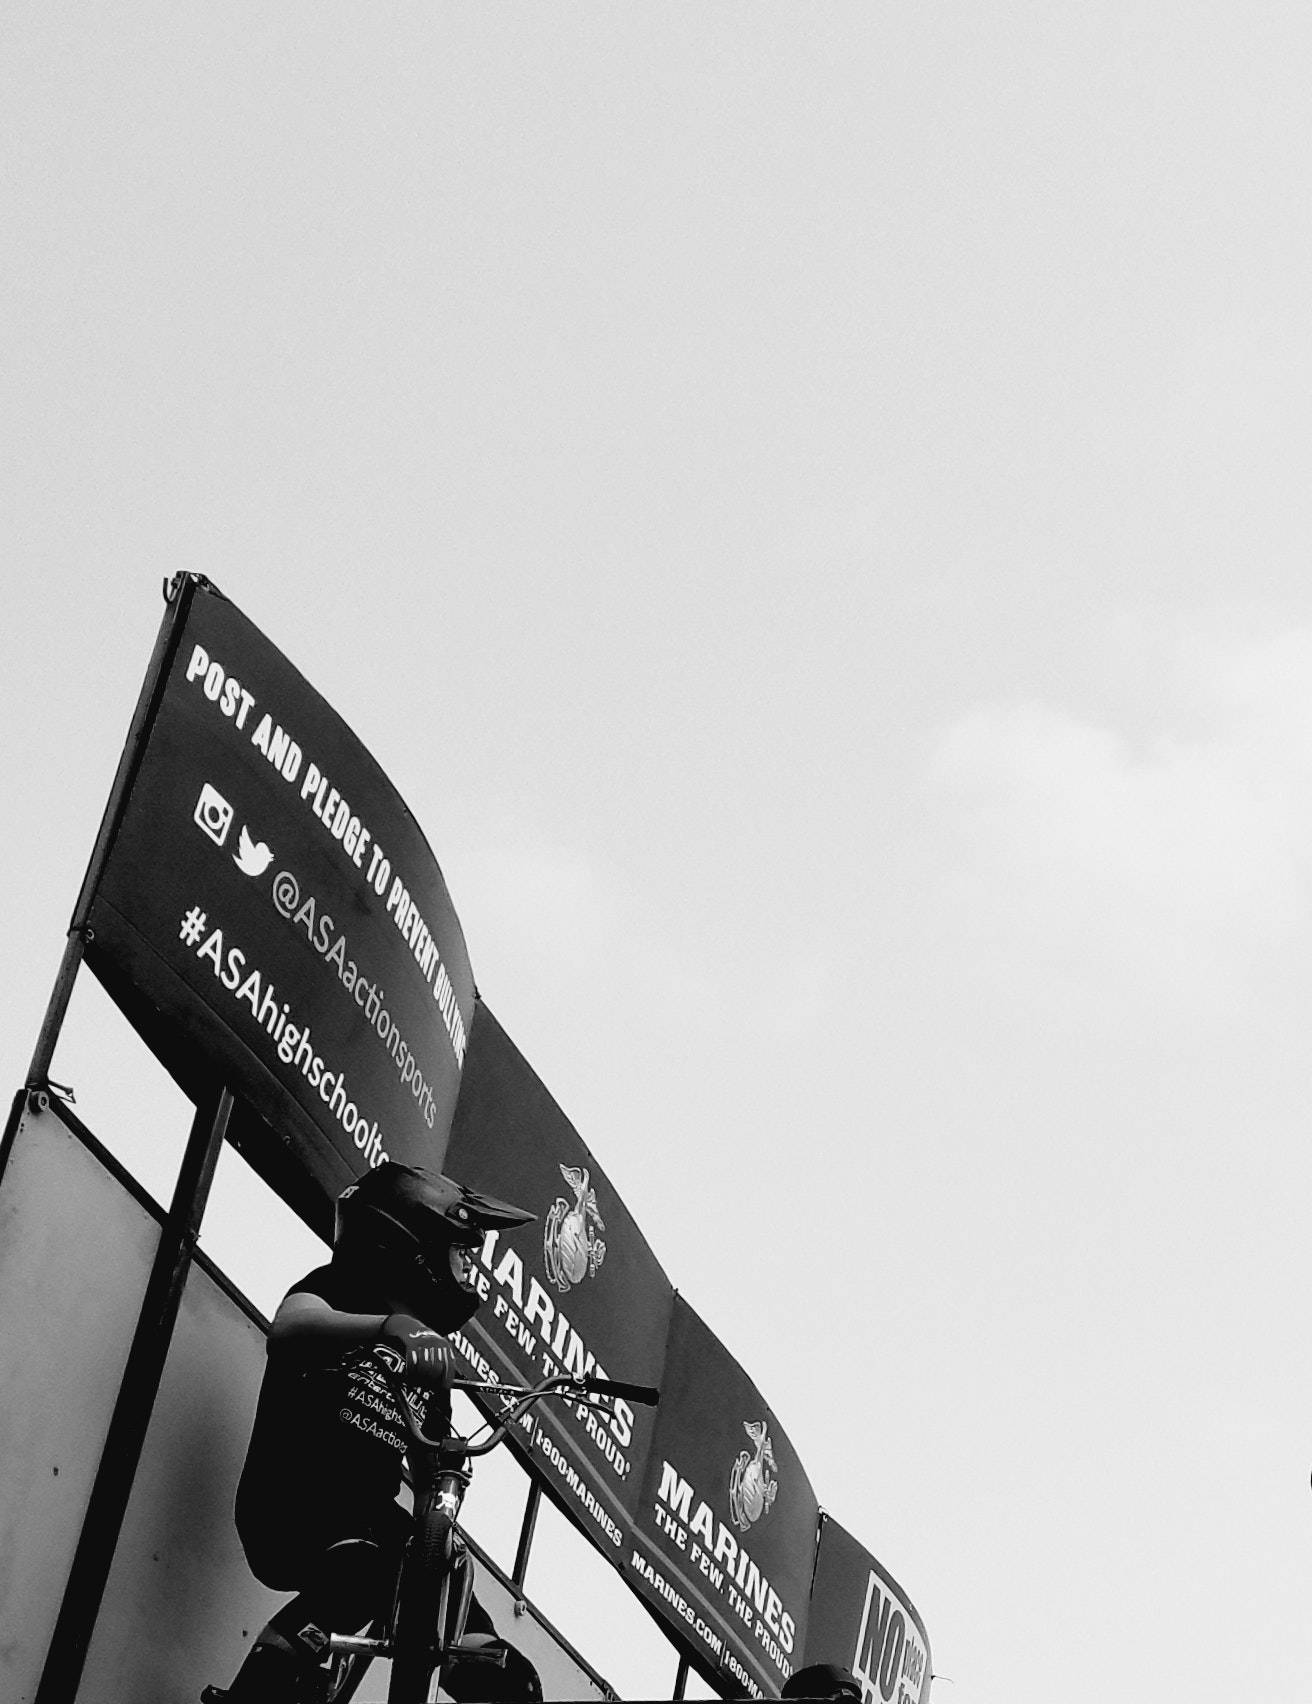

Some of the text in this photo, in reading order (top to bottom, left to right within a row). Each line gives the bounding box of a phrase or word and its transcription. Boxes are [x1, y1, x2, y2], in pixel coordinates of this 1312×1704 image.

[186, 644, 256, 730] POST
[251, 713, 302, 783] AND
[301, 762, 372, 869] PLEDGE
[365, 843, 392, 897] TO
[386, 875, 440, 983] PREVENT
[272, 871, 438, 1129] @ASAactionsports
[493, 1294, 536, 1361] FEW.
[575, 1402, 631, 1481] PROUD!
[631, 1550, 723, 1656] MARINES.COM
[654, 1502, 689, 1551] THE
[690, 1541, 725, 1595] FEW.
[727, 1584, 753, 1629] THE
[656, 1459, 796, 1654] MARINES
[858, 1583, 906, 1703] NO
